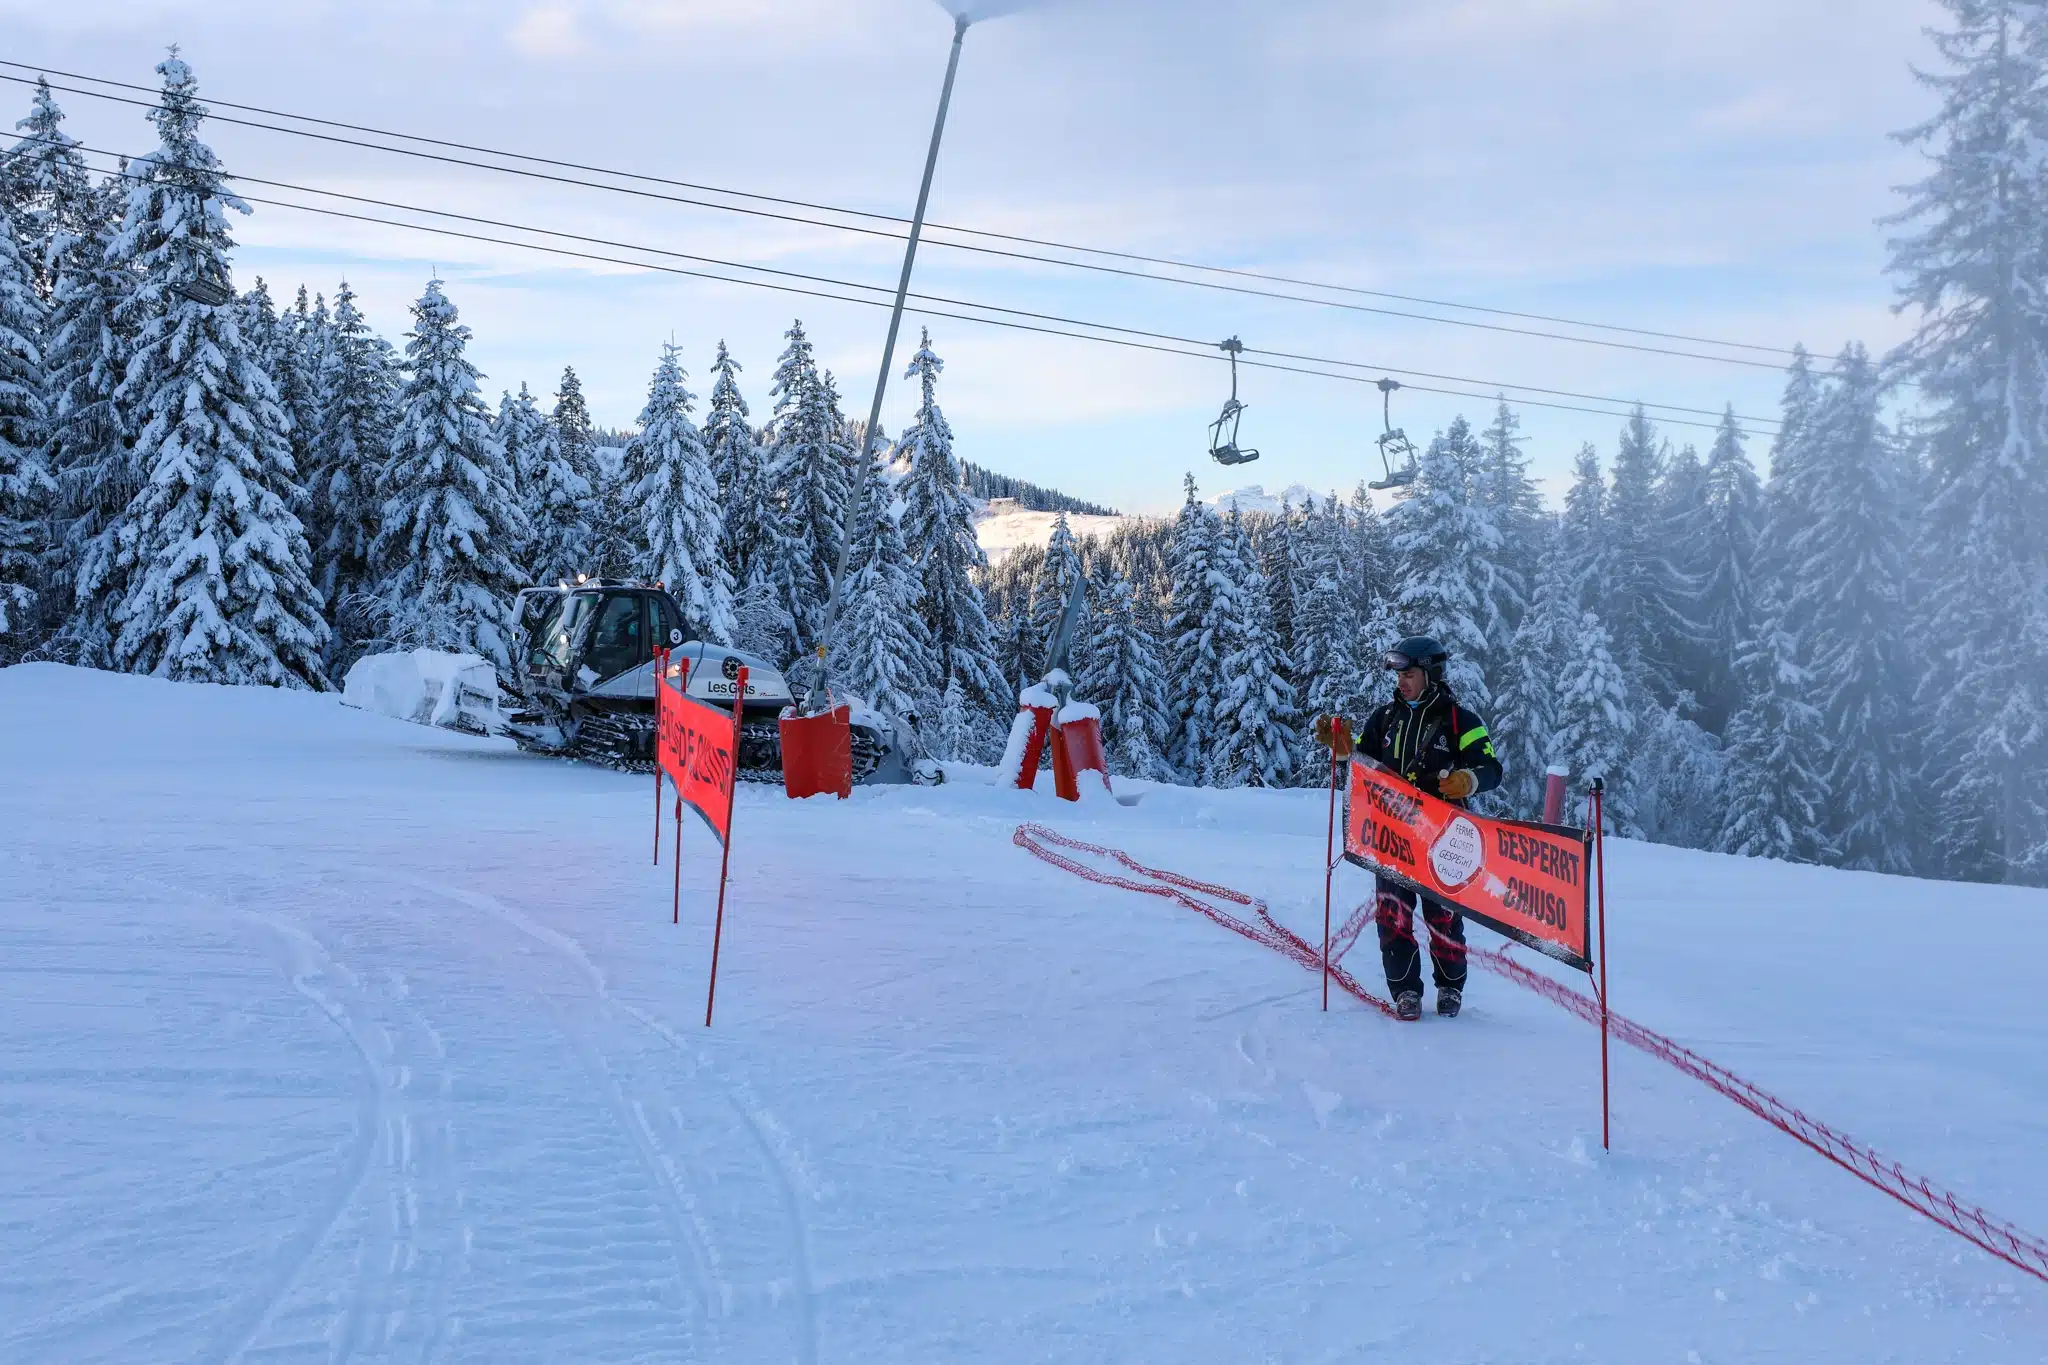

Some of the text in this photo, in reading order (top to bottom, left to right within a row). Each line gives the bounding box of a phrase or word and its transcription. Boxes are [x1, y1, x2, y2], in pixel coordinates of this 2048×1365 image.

[673, 632, 679, 641] 3
[708, 681, 727, 693] Les
[729, 682, 755, 695] Gts
[1361, 818, 1416, 866] CLOSED
[1449, 837, 1474, 853] CLOSED
[1496, 828, 1579, 886] GESPERRT
[1503, 876, 1567, 932] CHIUSO
